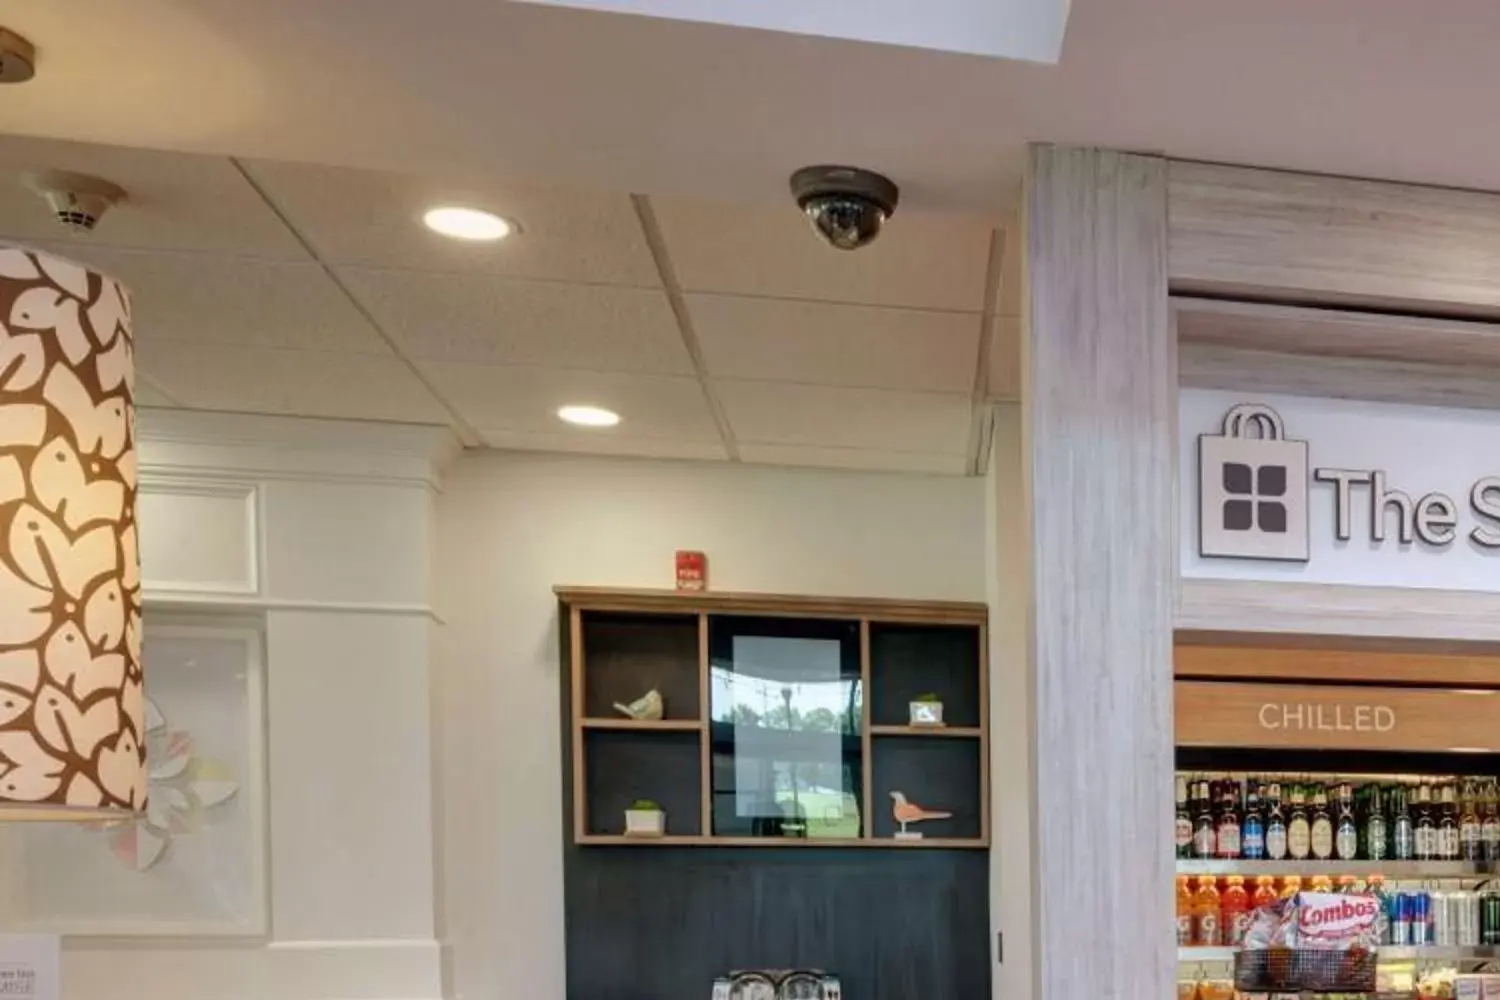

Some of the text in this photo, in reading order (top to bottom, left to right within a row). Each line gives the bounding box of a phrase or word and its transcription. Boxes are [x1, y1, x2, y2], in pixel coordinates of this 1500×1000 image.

[1315, 467, 1458, 546] The
[1258, 703, 1396, 732] CHILLED
[1300, 899, 1377, 926] Combos
